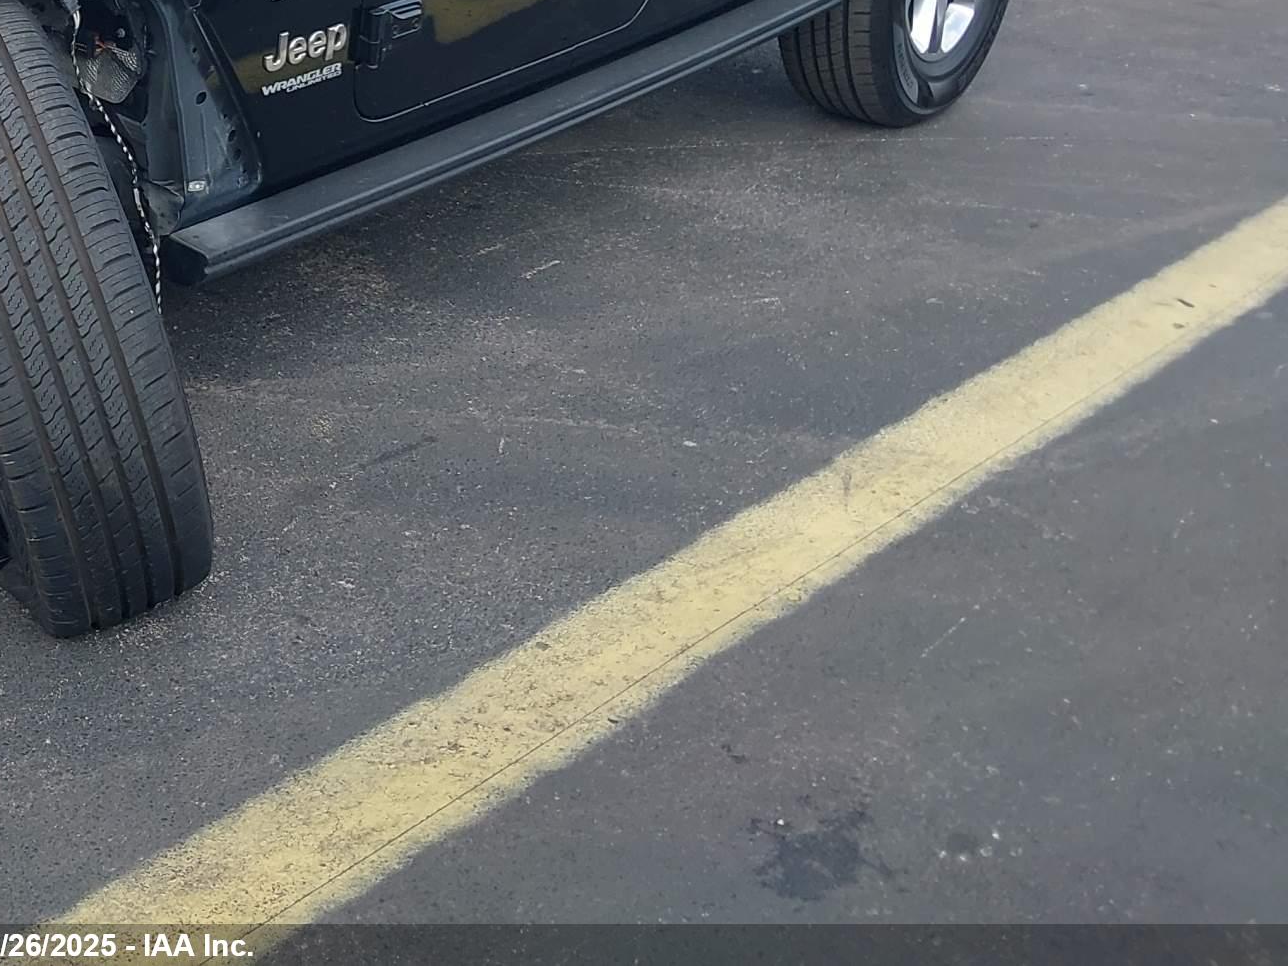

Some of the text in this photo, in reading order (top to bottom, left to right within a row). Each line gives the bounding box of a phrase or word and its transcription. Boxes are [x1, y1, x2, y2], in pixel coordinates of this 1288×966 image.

[263, 22, 348, 73] Jeep
[261, 62, 343, 96] WRANGLER
[285, 70, 343, 93] UNLIMITED
